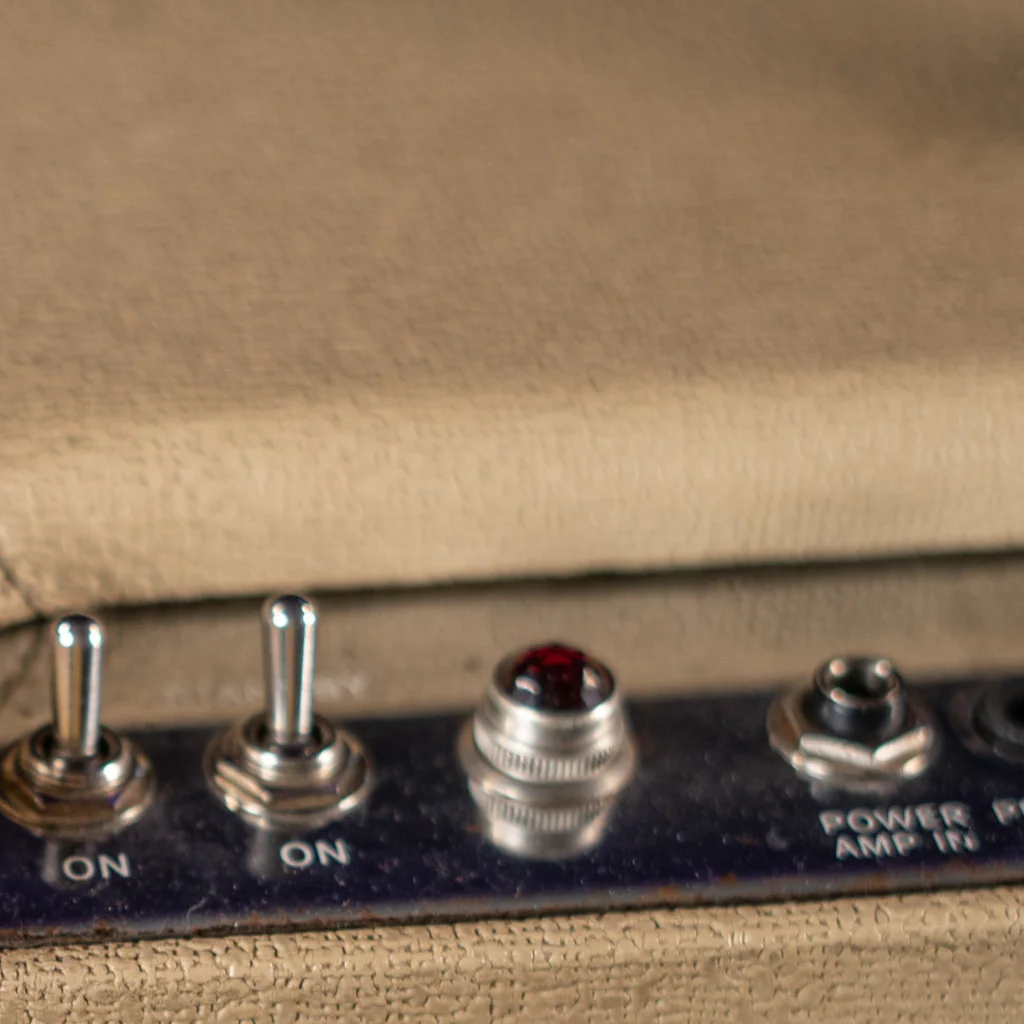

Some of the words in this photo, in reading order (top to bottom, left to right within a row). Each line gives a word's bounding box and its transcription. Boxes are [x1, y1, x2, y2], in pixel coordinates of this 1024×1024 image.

[818, 801, 971, 836] POWER
[279, 837, 351, 868] ON
[834, 831, 921, 861] AMP
[932, 829, 981, 853] IN
[62, 851, 132, 882] ON
